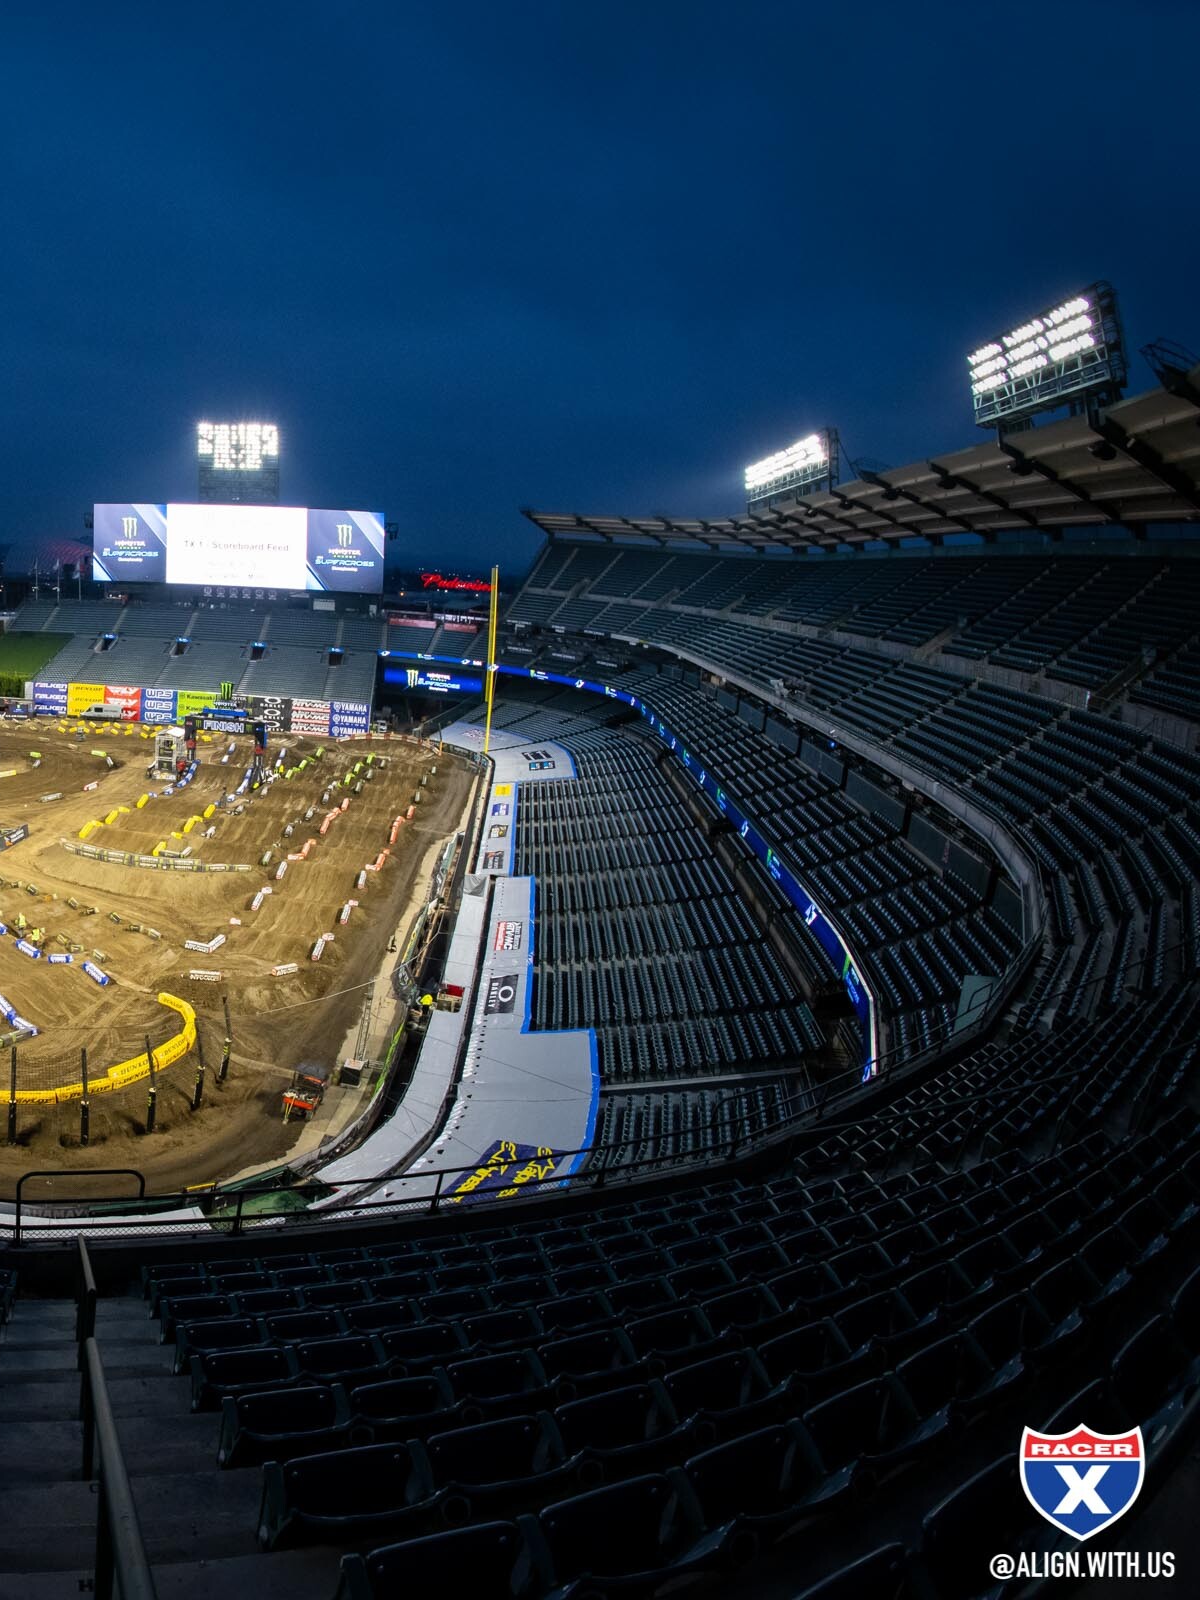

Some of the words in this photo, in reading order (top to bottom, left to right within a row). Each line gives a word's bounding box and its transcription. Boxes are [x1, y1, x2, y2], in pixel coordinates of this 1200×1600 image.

[212, 541, 264, 551] Scoreboard
[267, 543, 289, 552] Feed
[315, 559, 375, 567] SUPERCROSS
[146, 689, 173, 699] WPS
[145, 700, 173, 710] WPS
[341, 703, 367, 712] YAMAHA
[144, 711, 172, 721] WPS
[340, 715, 366, 724] YAMAHA
[203, 720, 245, 733] FINISH
[488, 982, 499, 1008] OAKLEY
[120, 1060, 149, 1075] DUNLO
